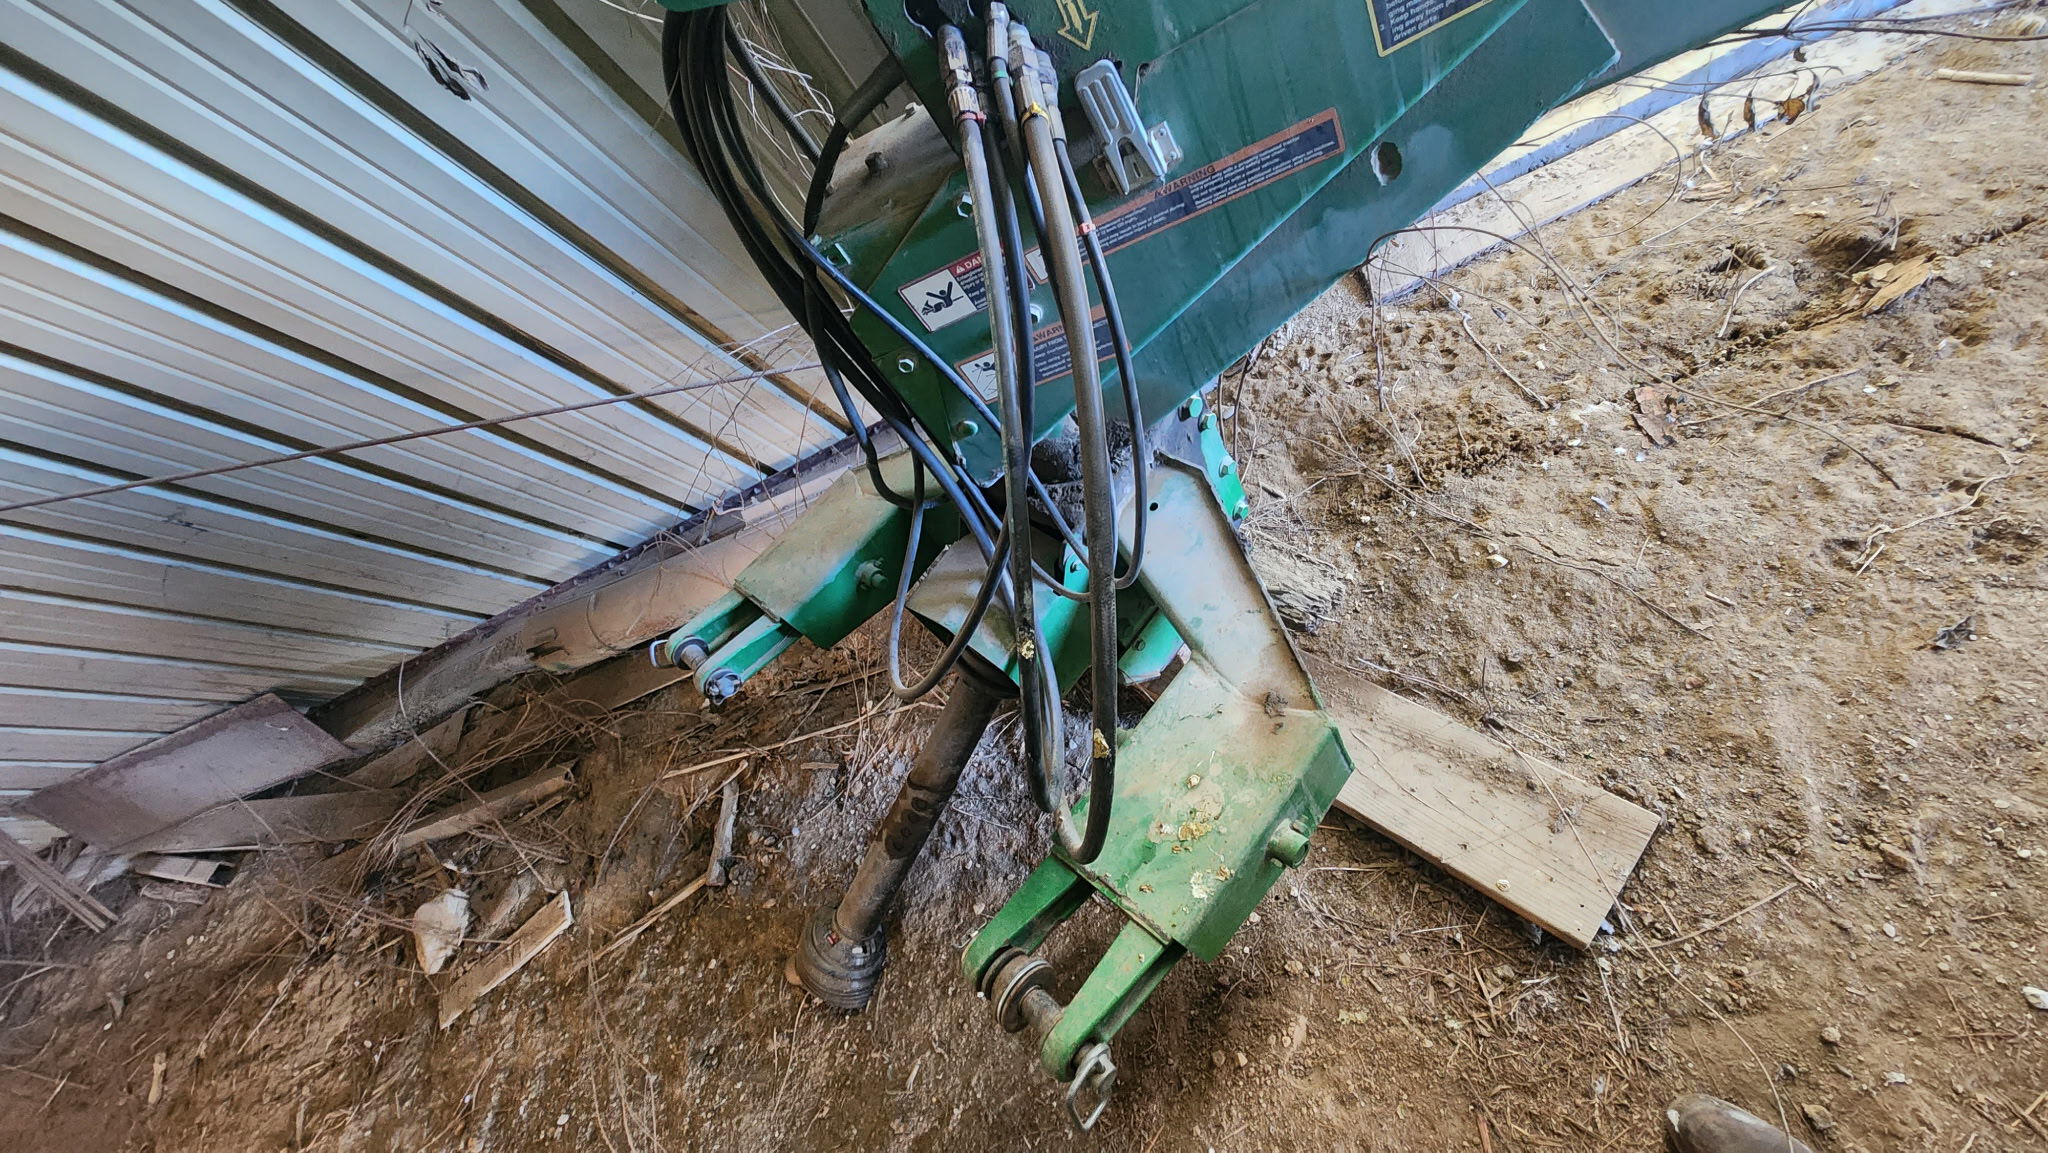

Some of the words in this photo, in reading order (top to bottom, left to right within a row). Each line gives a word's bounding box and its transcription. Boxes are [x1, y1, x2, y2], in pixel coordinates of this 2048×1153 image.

[1390, 12, 1409, 25] Keep
[1393, 26, 1417, 41] driven
[1159, 165, 1216, 194] WARNING
